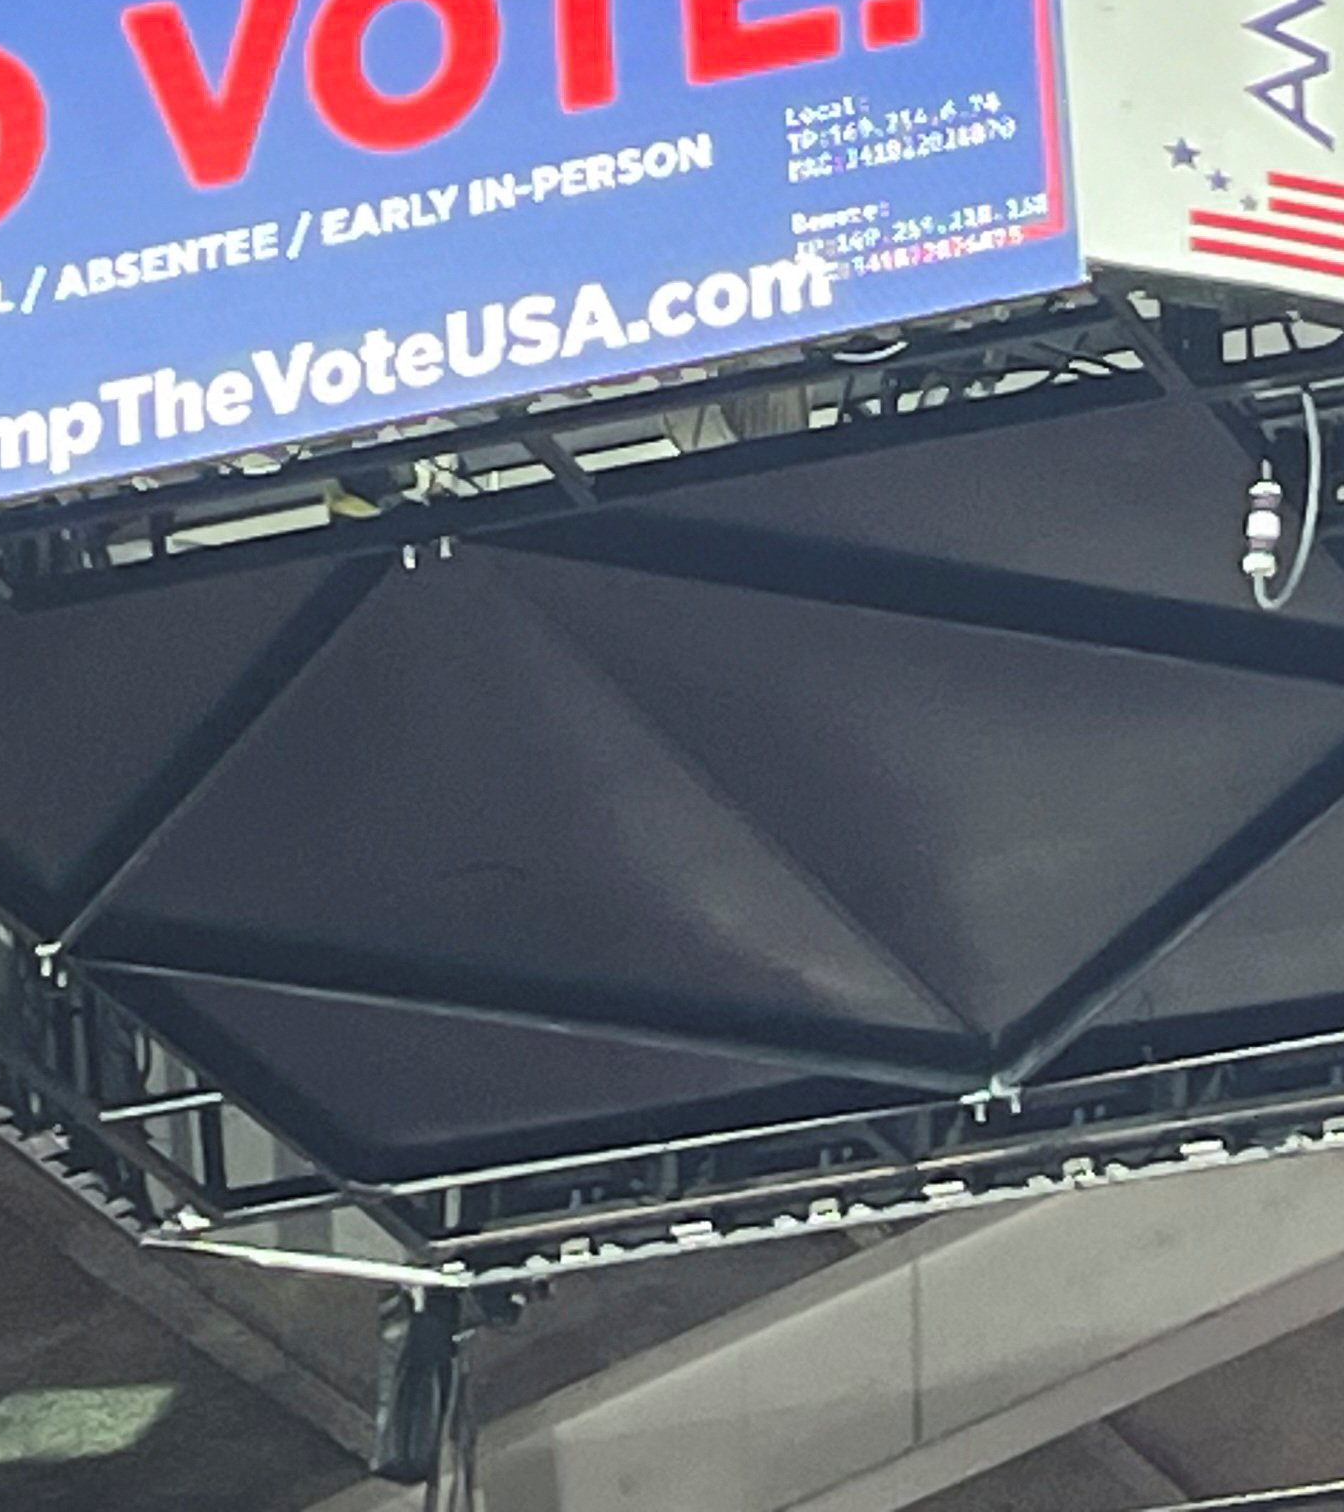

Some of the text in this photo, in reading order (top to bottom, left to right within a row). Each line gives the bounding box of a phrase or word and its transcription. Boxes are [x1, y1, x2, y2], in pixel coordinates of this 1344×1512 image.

[54, 221, 279, 301] ABSENTEE
[320, 185, 459, 246] EARLY
[469, 133, 714, 217] IN-PERSON
